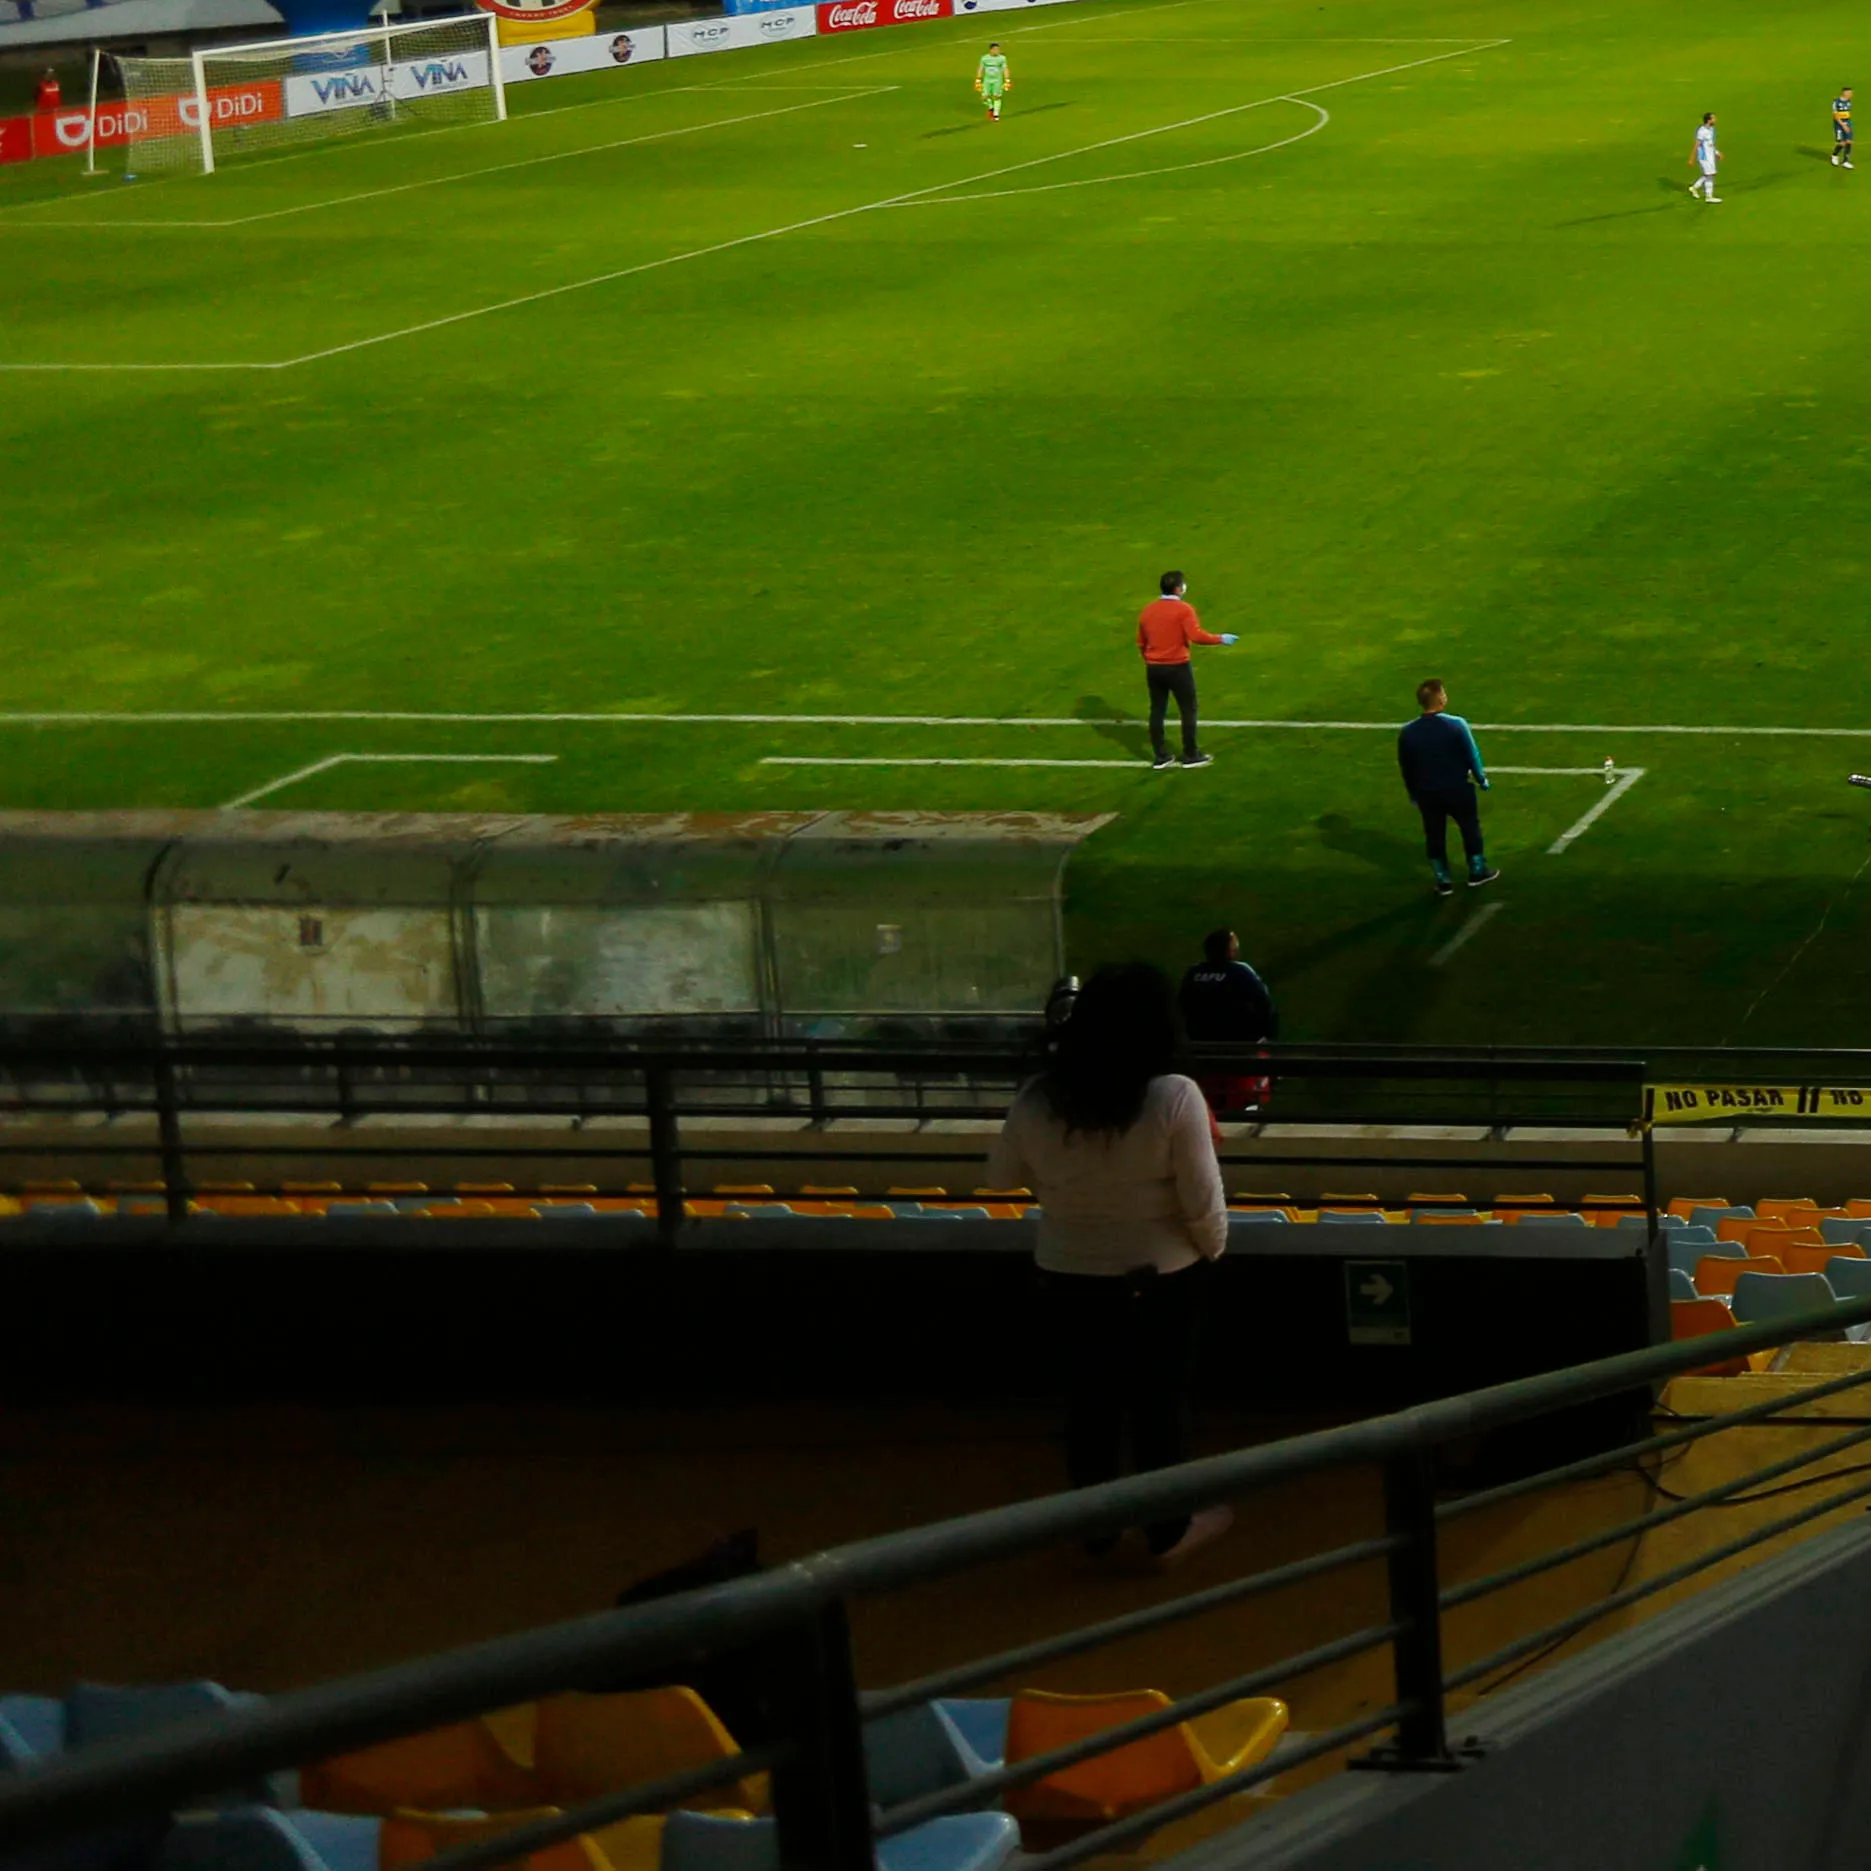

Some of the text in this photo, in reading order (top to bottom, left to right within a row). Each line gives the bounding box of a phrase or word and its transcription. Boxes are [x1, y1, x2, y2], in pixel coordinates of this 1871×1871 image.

[693, 27, 729, 39] MCP
[761, 16, 795, 29] MCP
[410, 59, 468, 89] VIÑA
[310, 72, 375, 105] VIÑA
[217, 92, 263, 120] DiDi
[99, 109, 148, 137] DiDi
[1665, 1088, 1785, 1111] NO PASAR
